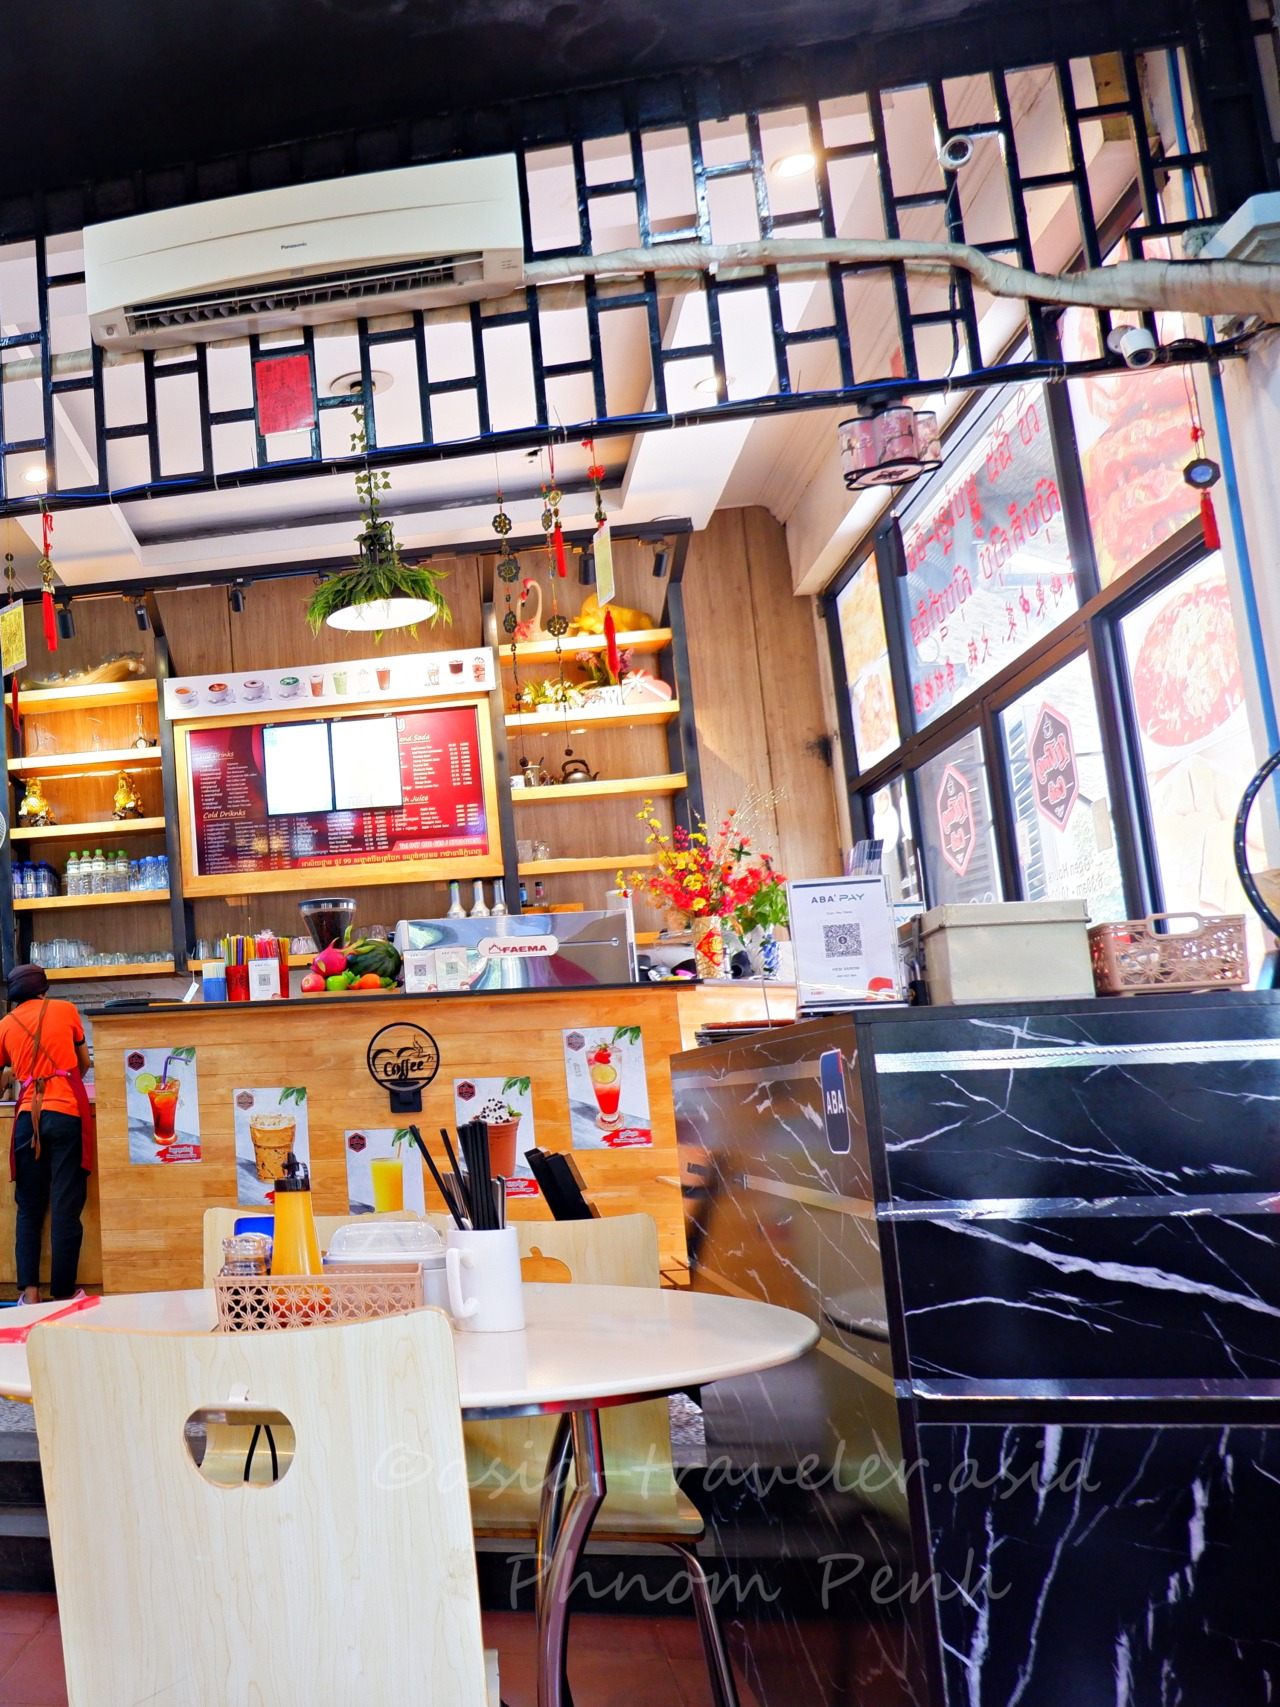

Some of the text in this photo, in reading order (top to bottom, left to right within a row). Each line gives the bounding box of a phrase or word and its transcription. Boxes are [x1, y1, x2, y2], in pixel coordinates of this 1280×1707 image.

[280, 242, 307, 250] Panasonic
[414, 733, 430, 741] Soda
[411, 795, 428, 803] Juice
[203, 810, 219, 819] Cold
[811, 893, 865, 904] ABA PAY
[502, 945, 547, 953] FAEMA
[827, 1089, 845, 1115] ABA
